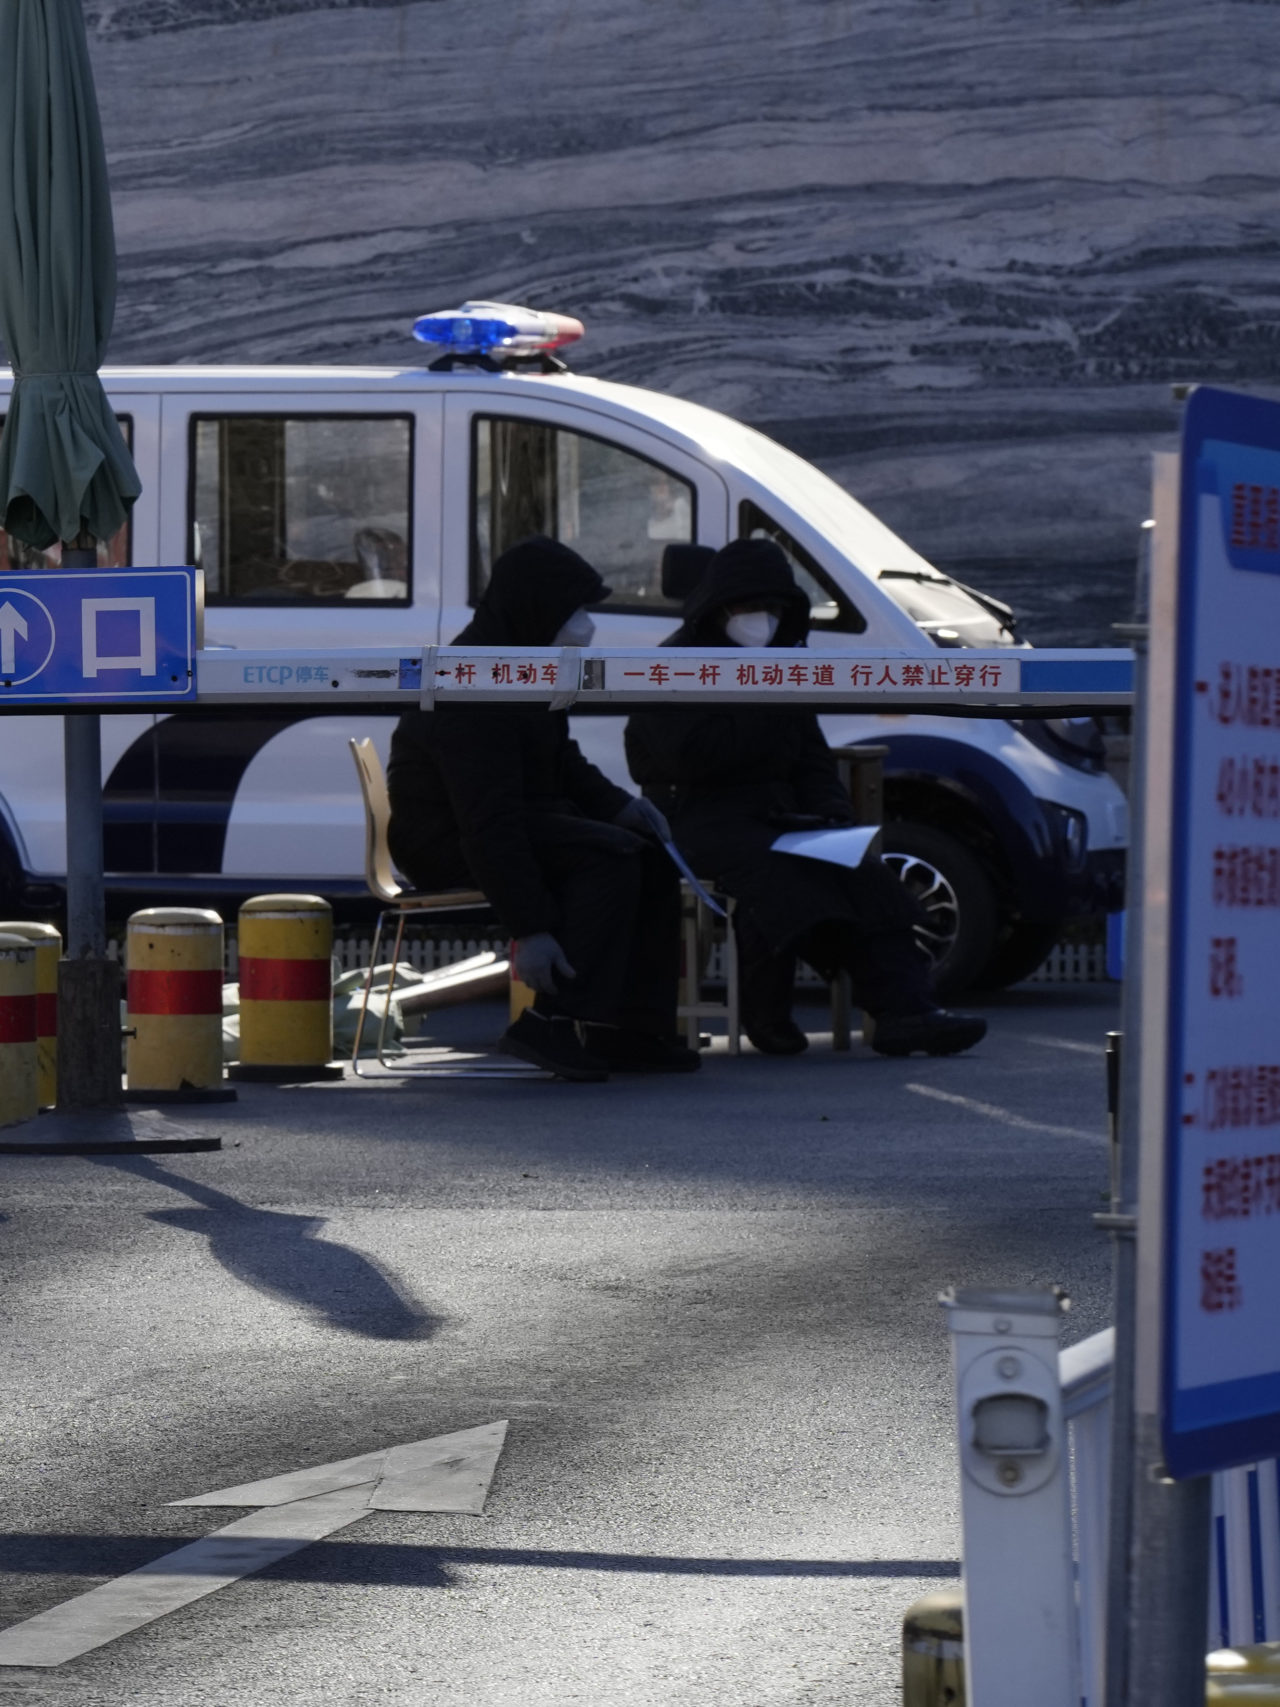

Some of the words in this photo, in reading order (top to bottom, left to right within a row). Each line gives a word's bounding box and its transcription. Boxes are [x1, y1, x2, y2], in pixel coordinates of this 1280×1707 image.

[81, 596, 157, 678] 口
[623, 663, 721, 686] 一车一杆
[736, 663, 835, 686] 机动车道
[850, 663, 1002, 687] 行人禁止穿行
